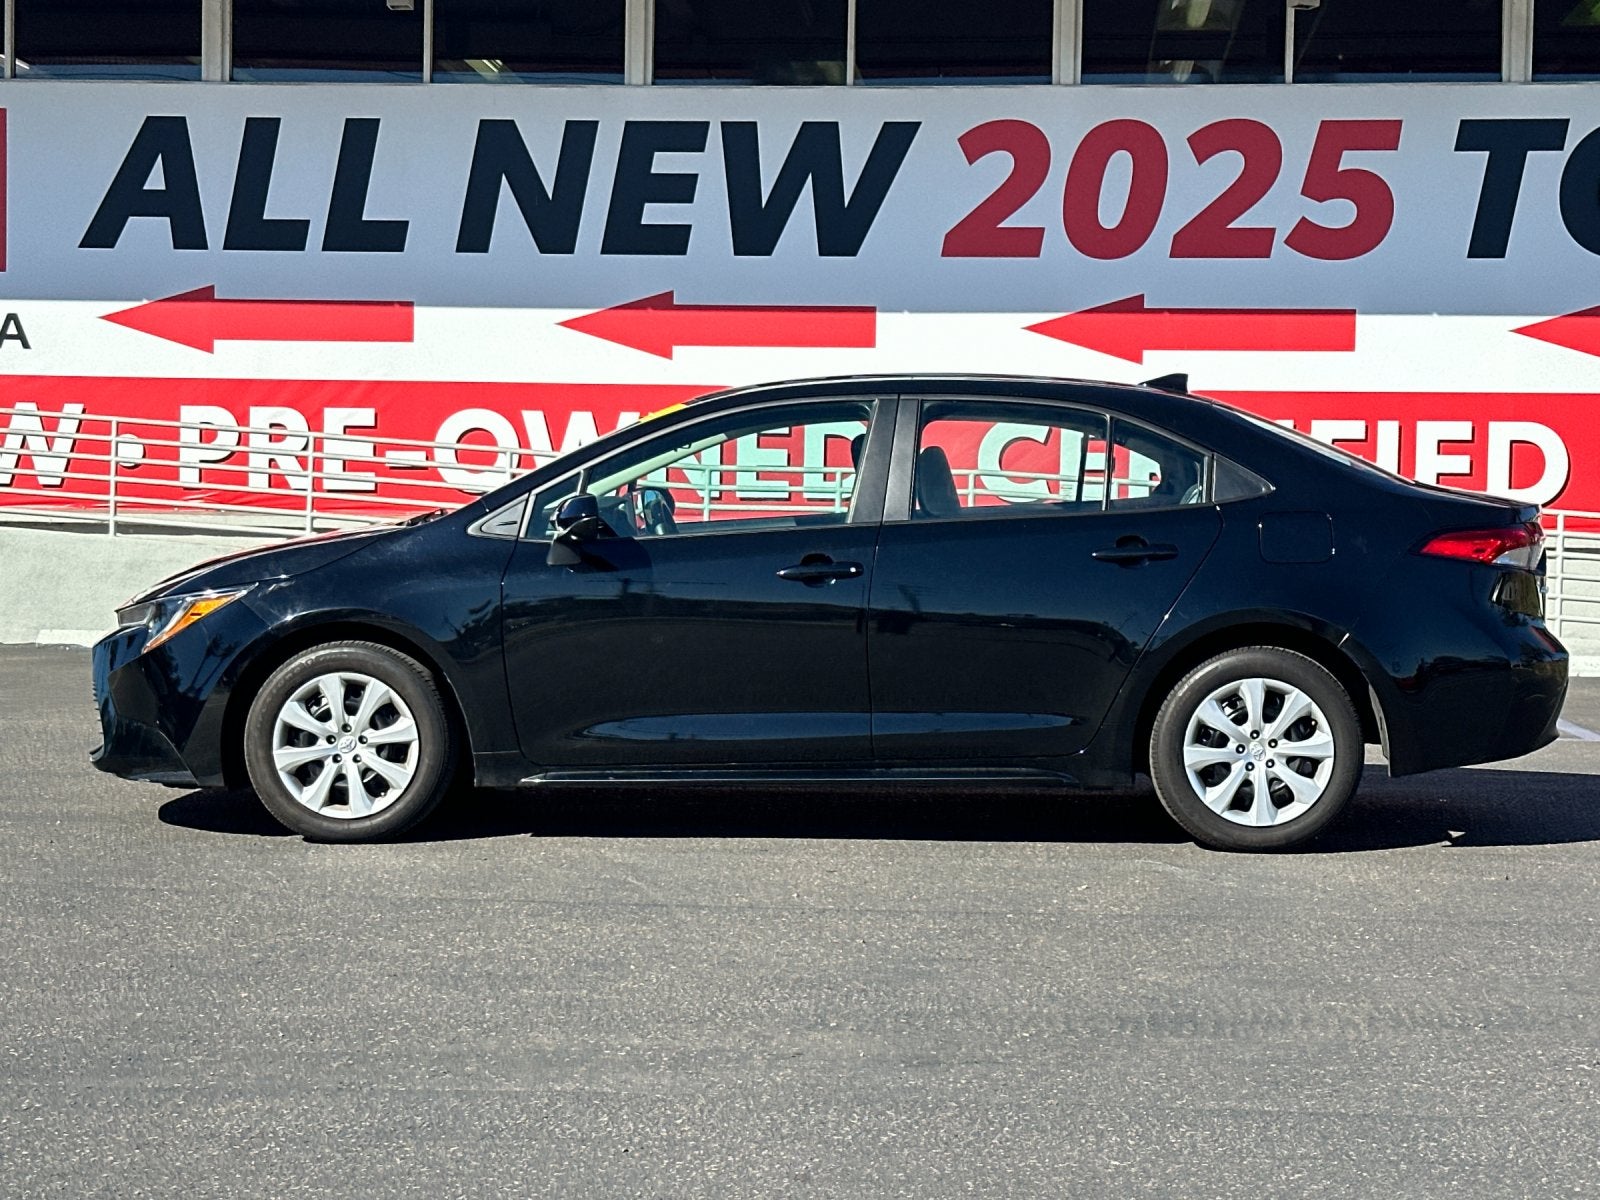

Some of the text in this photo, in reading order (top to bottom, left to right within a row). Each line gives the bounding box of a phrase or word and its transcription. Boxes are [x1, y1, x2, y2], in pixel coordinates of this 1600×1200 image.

[78, 115, 410, 253] ALL
[455, 118, 922, 258] NEW
[940, 118, 1404, 260] 2025
